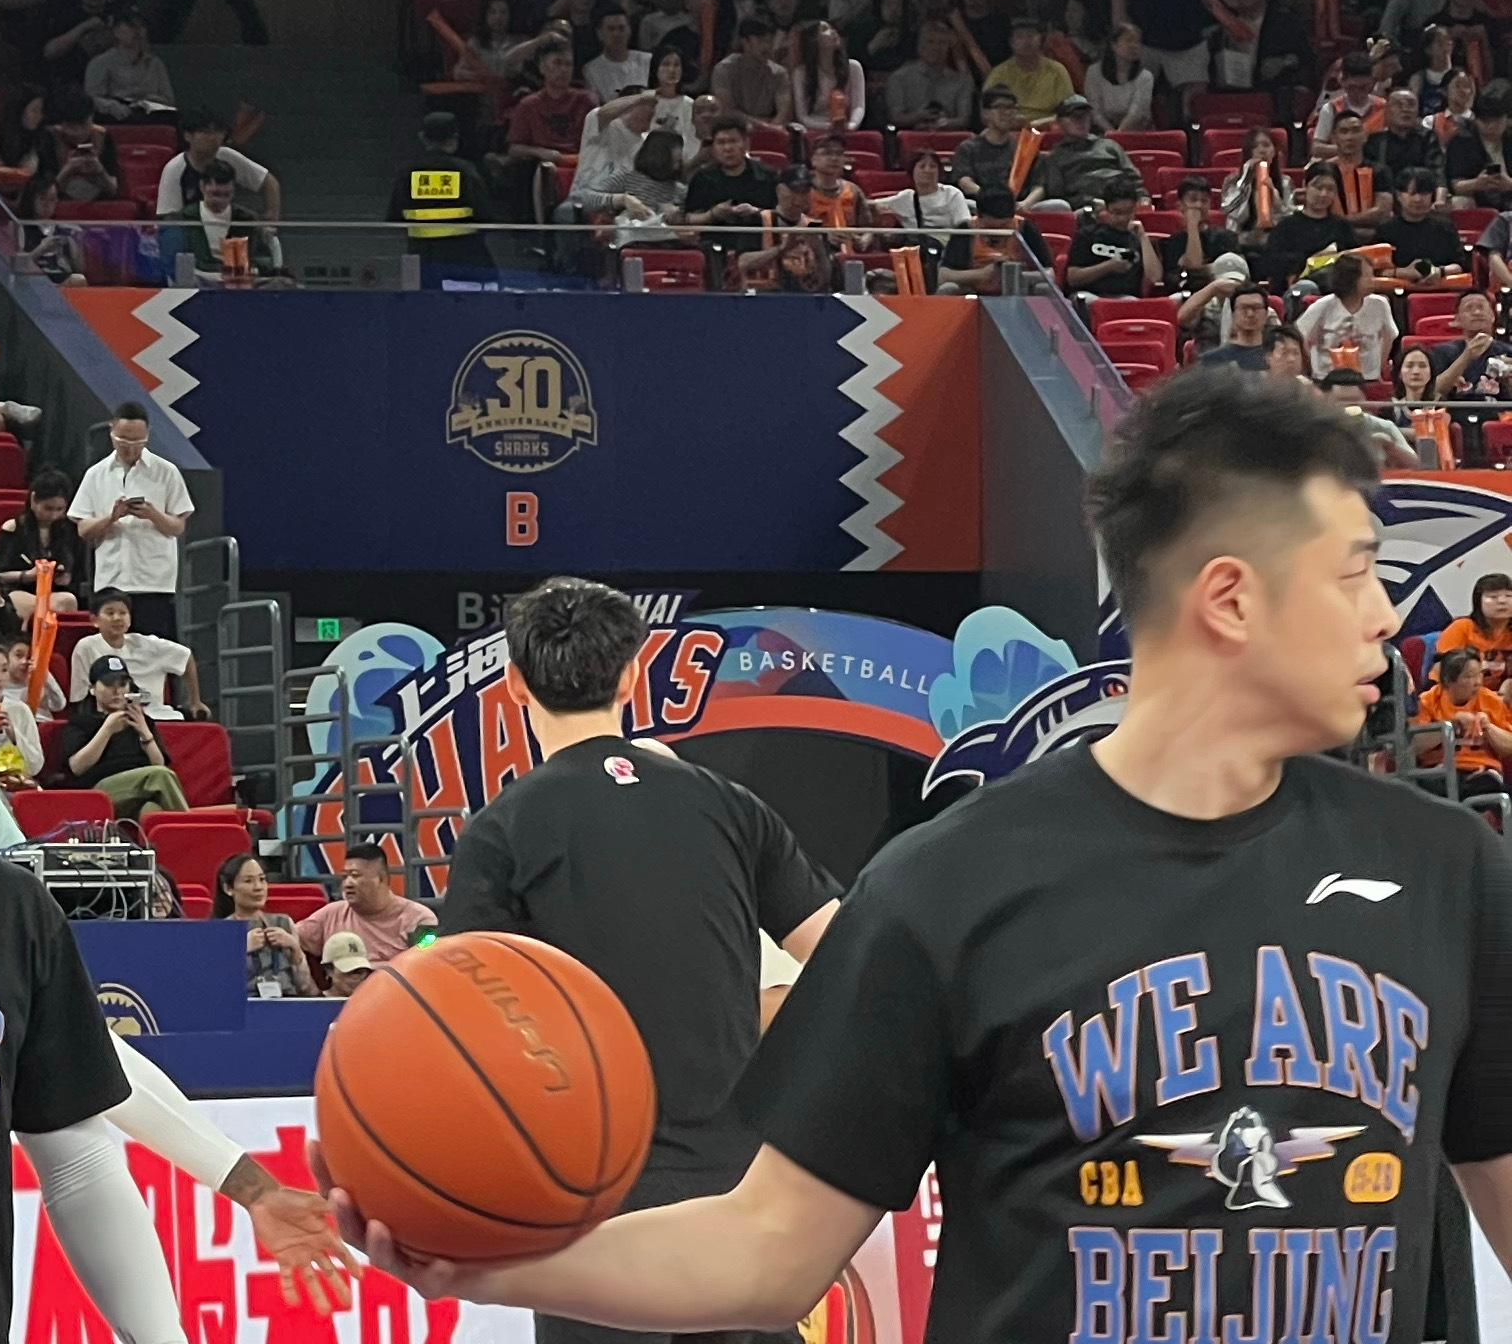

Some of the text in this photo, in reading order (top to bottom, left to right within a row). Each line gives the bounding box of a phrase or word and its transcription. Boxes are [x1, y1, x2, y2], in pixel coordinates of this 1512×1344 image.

[482, 355, 562, 418] 30
[476, 416, 569, 432] ANNIVERSARY
[494, 440, 550, 457] SHARKS
[506, 491, 538, 546] B
[739, 650, 930, 696] BASKETBALL
[314, 629, 725, 899] SHAKS
[1042, 945, 1429, 1146] WE ARE
[1079, 1160, 1144, 1207] CBA
